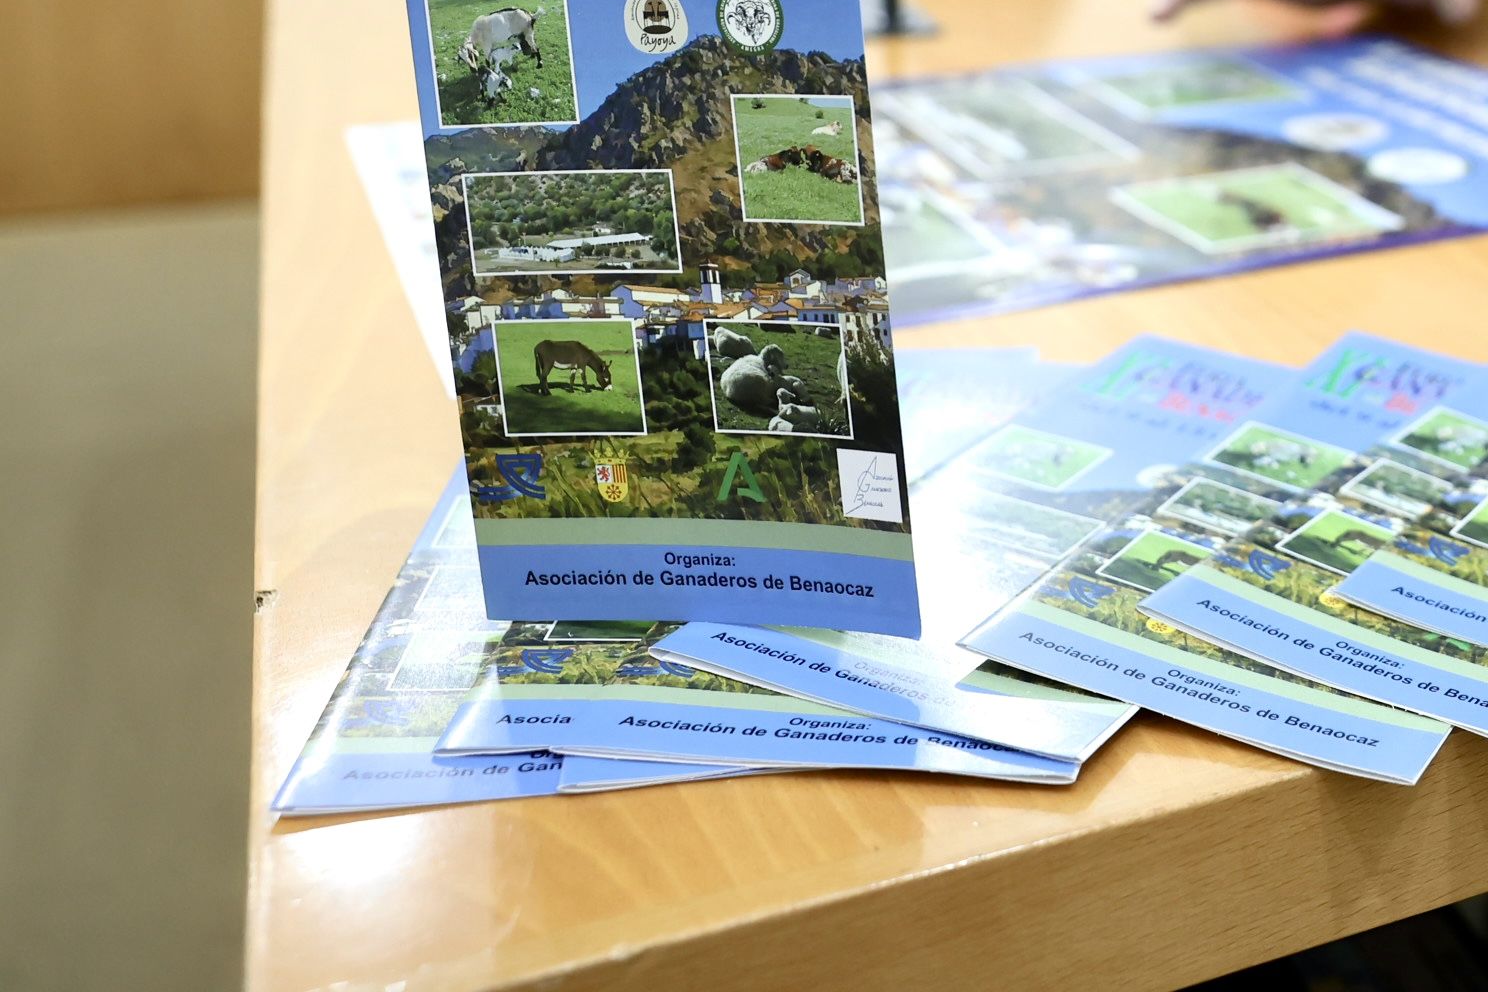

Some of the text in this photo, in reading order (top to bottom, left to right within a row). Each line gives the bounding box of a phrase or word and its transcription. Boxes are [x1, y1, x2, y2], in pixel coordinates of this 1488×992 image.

[640, 33, 676, 52] Payoya
[664, 551, 736, 569] Organiza:
[525, 569, 875, 599] Asociación de Ganaderos de Benaocaz
[1390, 584, 1487, 624] Asociación
[1196, 598, 1290, 641] Asociación
[1292, 634, 1315, 651] de
[1318, 646, 1414, 688] Ganaderos
[1416, 680, 1440, 696] de
[1335, 639, 1405, 670] Organiza:
[711, 630, 806, 669] Asociación
[808, 660, 832, 675] de
[834, 668, 930, 702] Ganaderos
[1018, 630, 1380, 748] Asociación de Ganaderos de Benaocaz
[1167, 668, 1241, 697] Organiza:
[497, 712, 571, 727] Asocia
[618, 715, 735, 736] Asociación
[741, 721, 768, 738] de
[774, 727, 887, 746] Ganaderos
[893, 734, 919, 747] de
[789, 717, 873, 732] Organiza:
[482, 764, 510, 776] de
[518, 760, 563, 774] Gan
